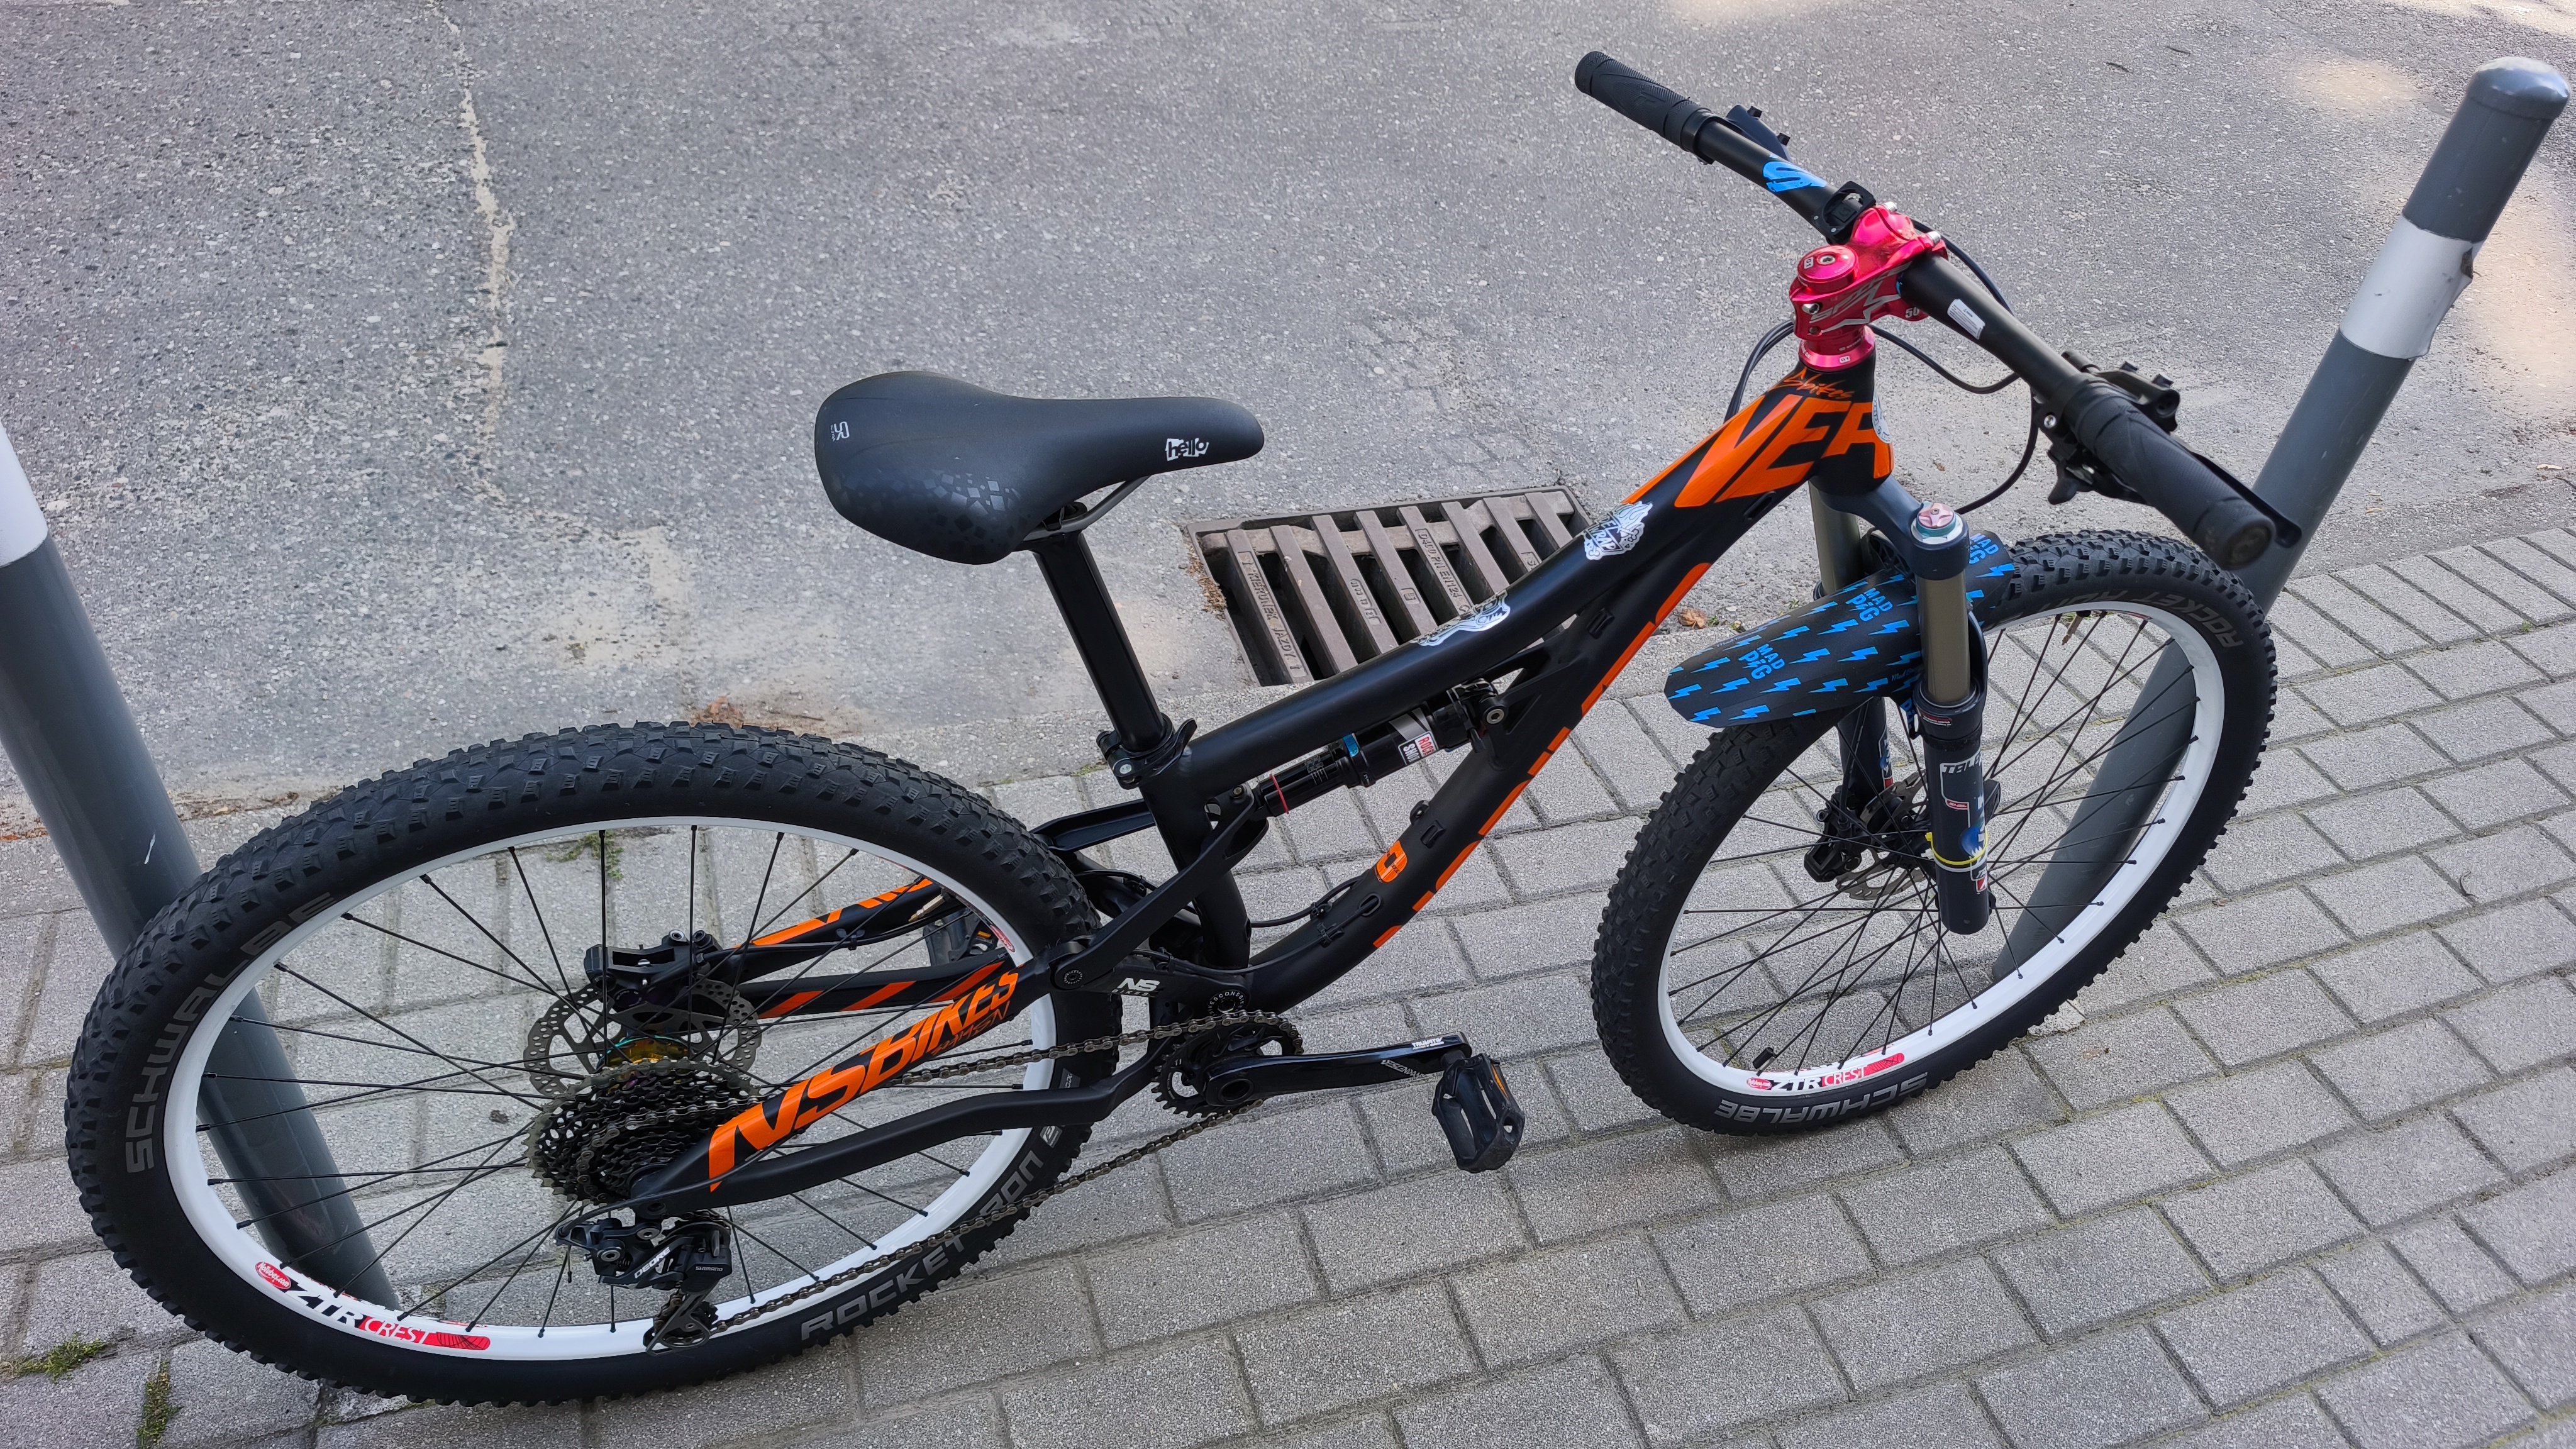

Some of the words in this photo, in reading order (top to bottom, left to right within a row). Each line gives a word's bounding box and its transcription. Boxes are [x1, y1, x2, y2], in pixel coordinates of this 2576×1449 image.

[1906, 308, 1919, 318] 50
[1167, 438, 1208, 460] hello
[1863, 587, 1893, 611] MAD
[2132, 591, 2244, 647] ROCKET
[1757, 643, 1785, 669] MAD
[1117, 977, 1160, 992] NS
[126, 892, 338, 1174] SCHWALBE
[1772, 1077, 1821, 1091] ZTR
[1824, 1065, 1869, 1087] CREST
[1714, 1072, 1928, 1124] SCHWALBE
[634, 1246, 671, 1279] DEORE
[801, 1234, 965, 1341] ROCKET
[284, 1289, 364, 1328] ZTR
[364, 1318, 434, 1345] CREST
